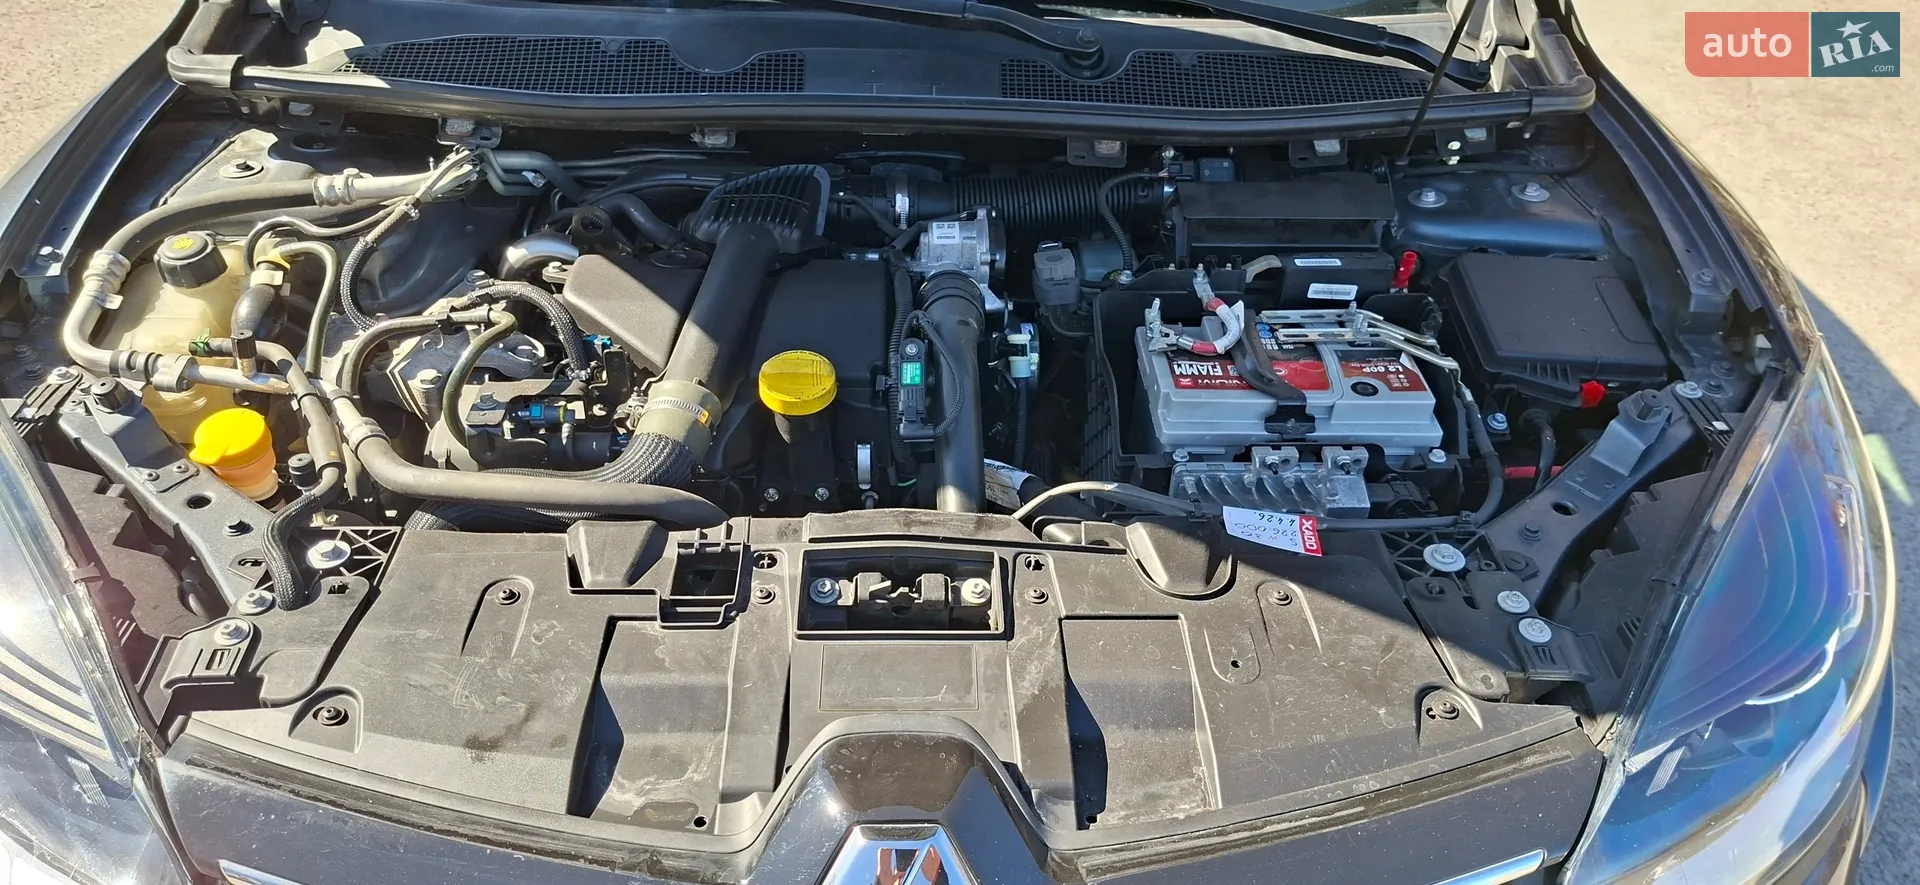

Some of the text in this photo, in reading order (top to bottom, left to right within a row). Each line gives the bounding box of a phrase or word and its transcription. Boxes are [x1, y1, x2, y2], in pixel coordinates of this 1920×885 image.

[1173, 362, 1223, 376] FIAMM
[1362, 365, 1386, 373] 60P
[1301, 518, 1317, 550] XADO
